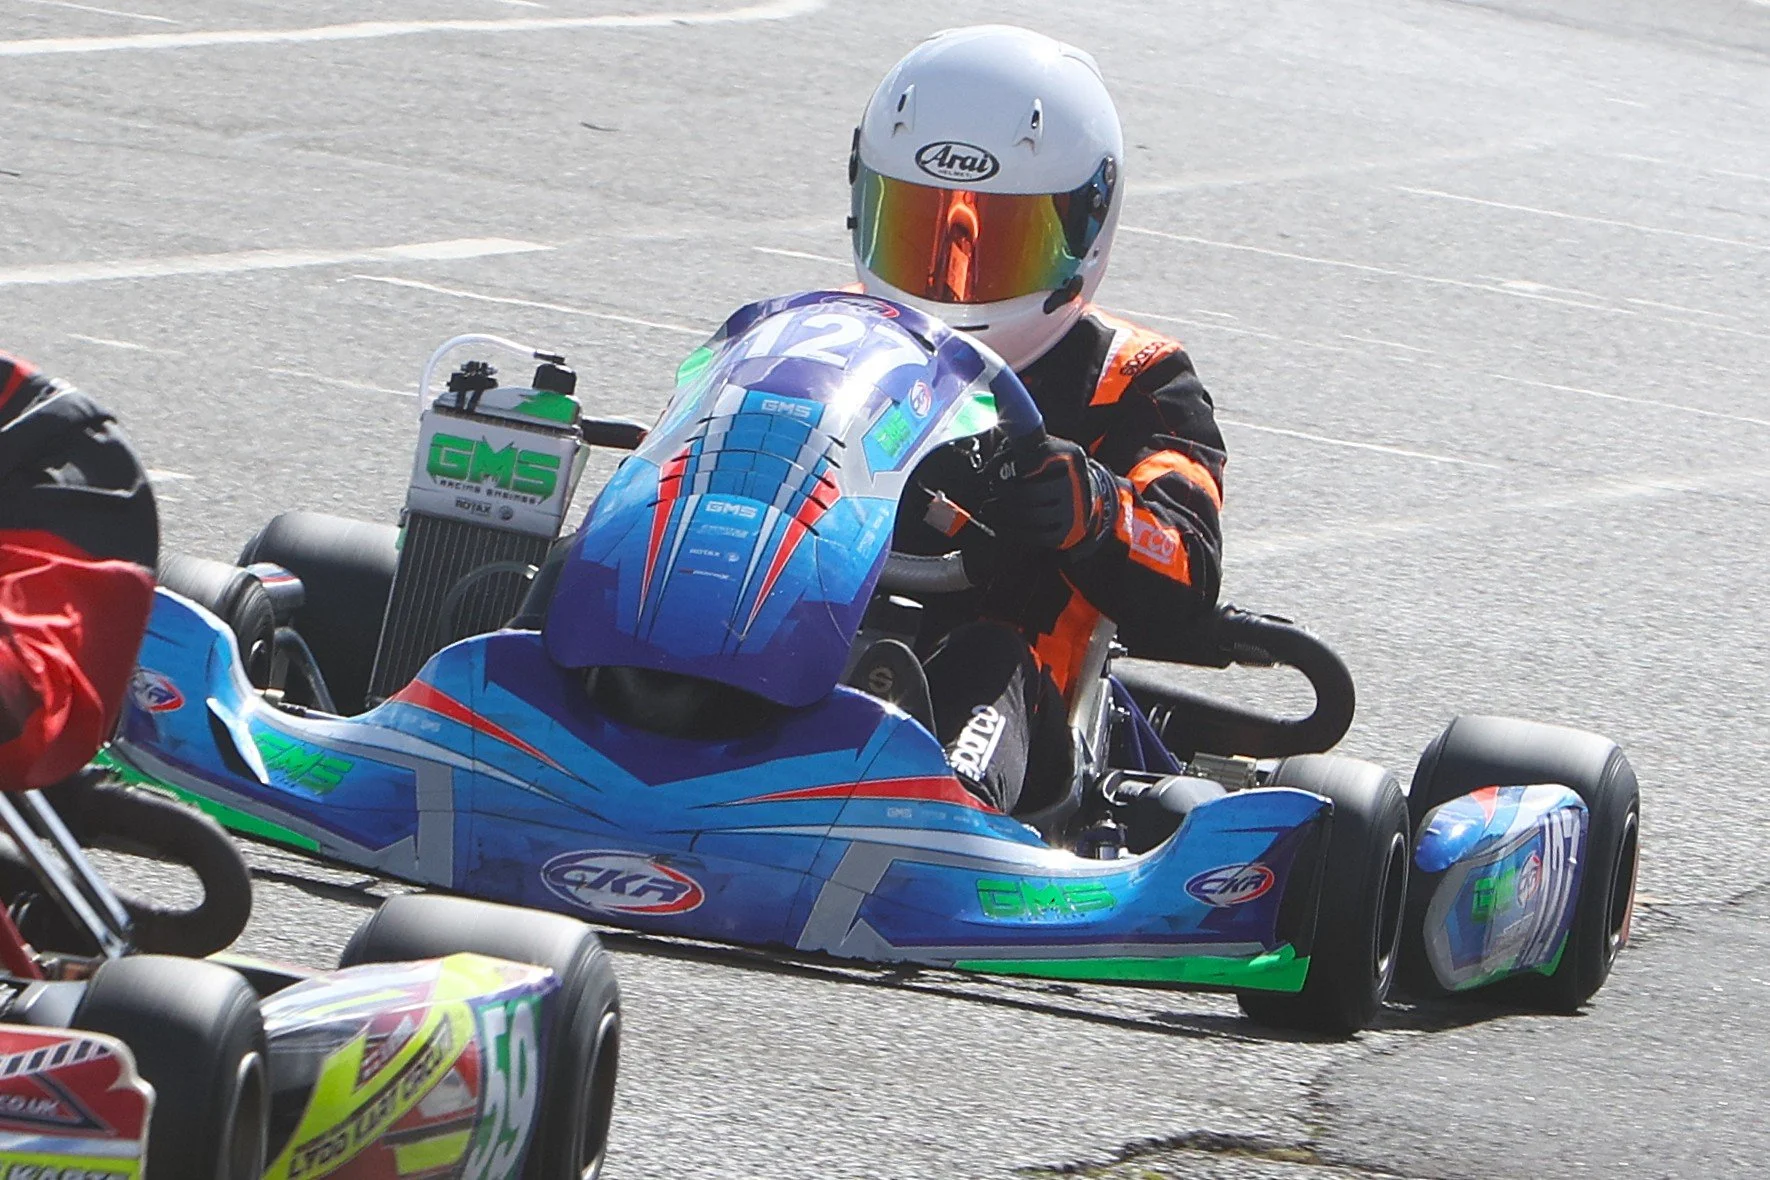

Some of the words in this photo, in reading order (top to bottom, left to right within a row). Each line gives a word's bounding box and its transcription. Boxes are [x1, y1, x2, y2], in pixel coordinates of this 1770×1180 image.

[921, 145, 990, 173] Arai
[761, 399, 813, 418] GMS
[426, 432, 562, 505] GMS
[455, 498, 492, 515] ROTAX
[705, 500, 758, 519] GMS
[549, 863, 692, 903] CKR
[976, 878, 1118, 919] GMS
